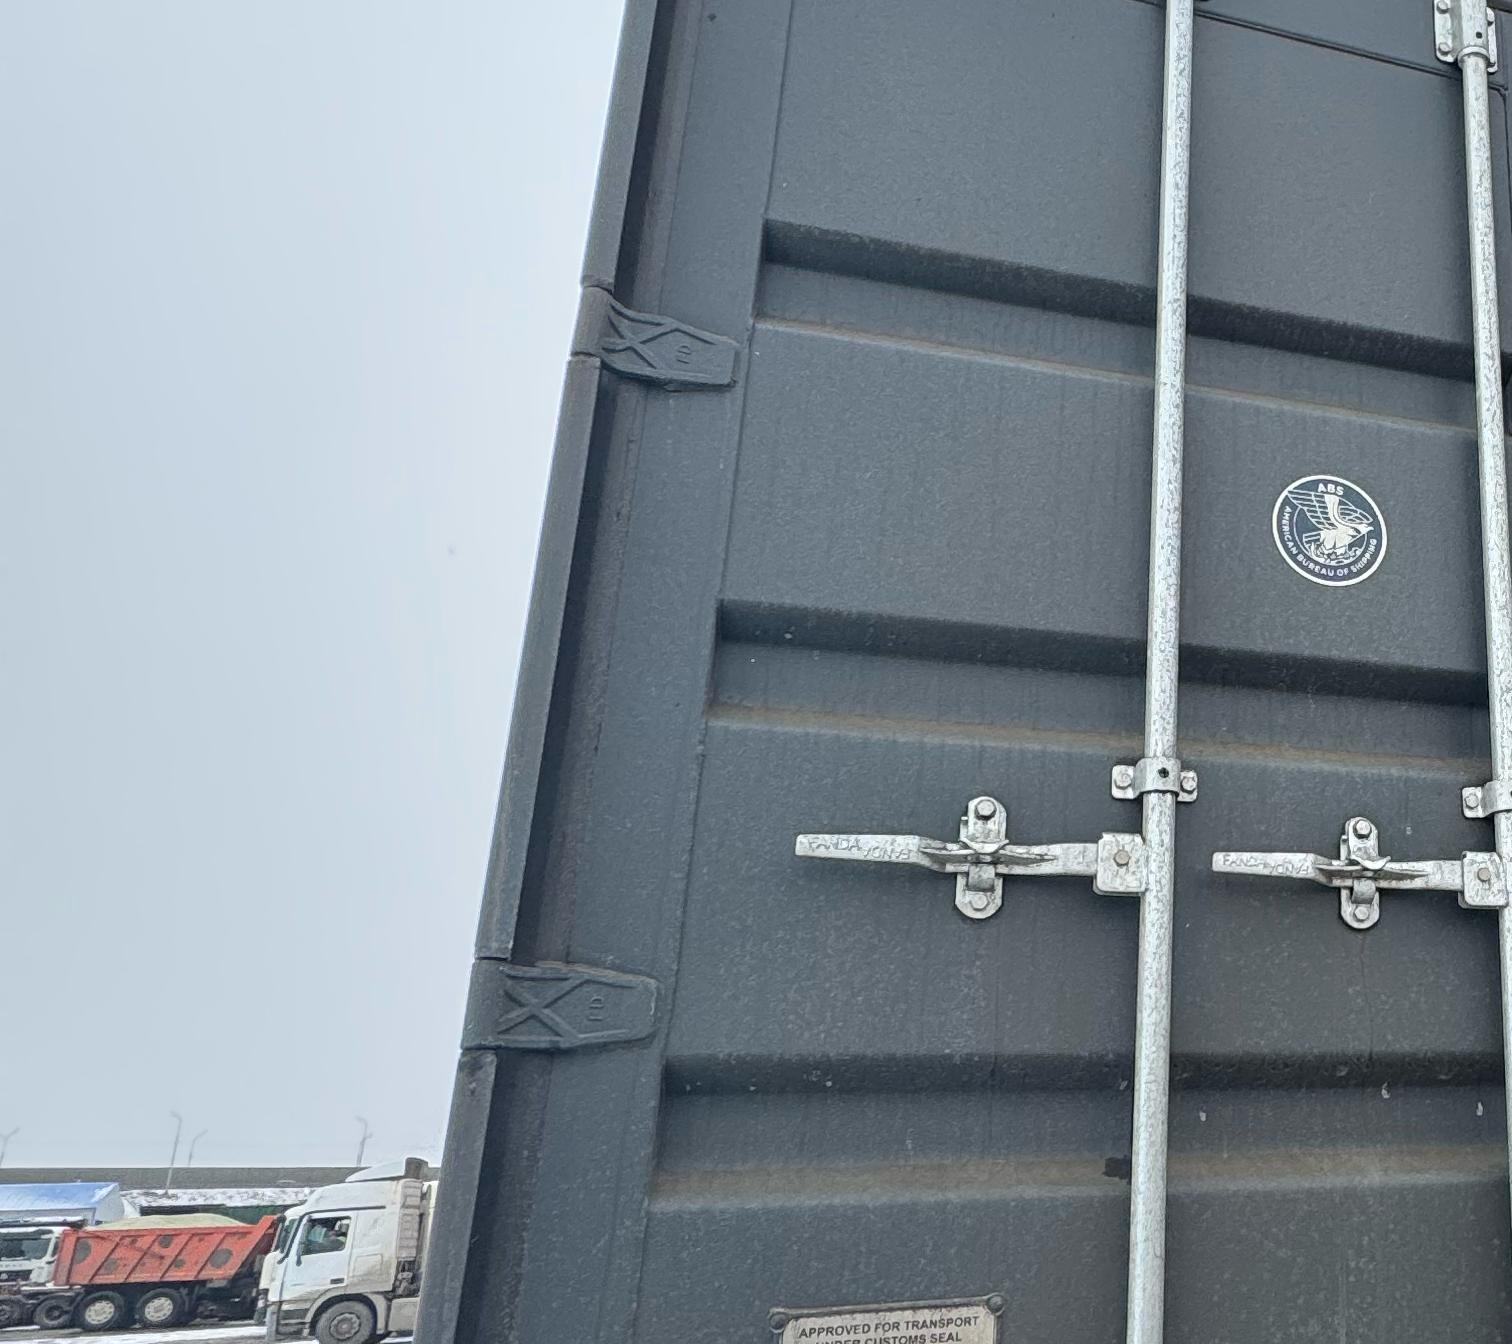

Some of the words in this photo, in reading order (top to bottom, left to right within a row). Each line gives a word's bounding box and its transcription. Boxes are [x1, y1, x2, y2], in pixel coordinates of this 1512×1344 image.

[1317, 482, 1344, 496] ABS
[1280, 505, 1299, 555] AMERICAN
[1296, 553, 1335, 577] BUREAU
[1336, 567, 1350, 577] OF
[1350, 537, 1378, 573] SHIPPING
[799, 1323, 871, 1339] APPROVED
[874, 1321, 900, 1333] FOR
[904, 1316, 979, 1331] TRANSPORT
[930, 1331, 962, 1344] SEAL
